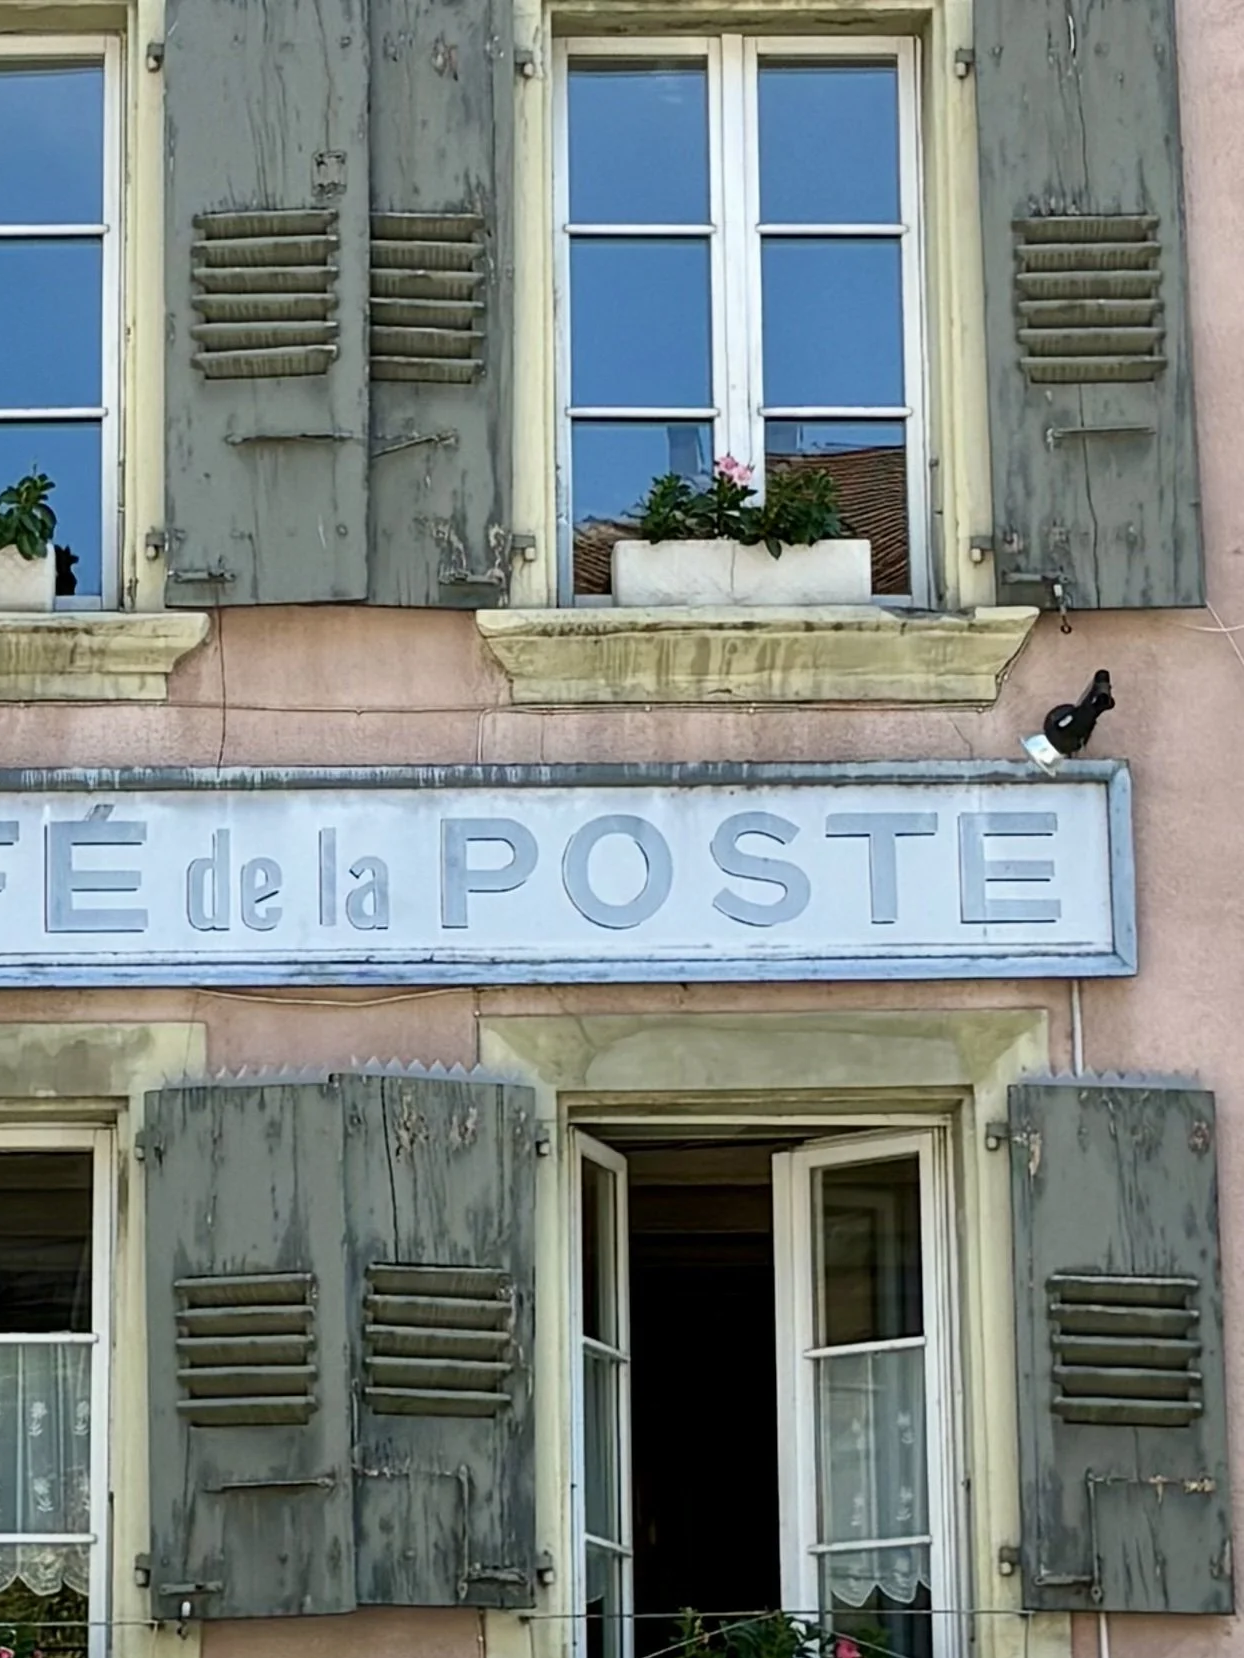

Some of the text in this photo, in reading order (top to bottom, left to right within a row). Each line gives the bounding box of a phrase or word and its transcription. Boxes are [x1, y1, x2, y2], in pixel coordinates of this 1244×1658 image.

[186, 828, 282, 932] de
[318, 827, 389, 931] la
[440, 811, 1062, 930] POSTE
